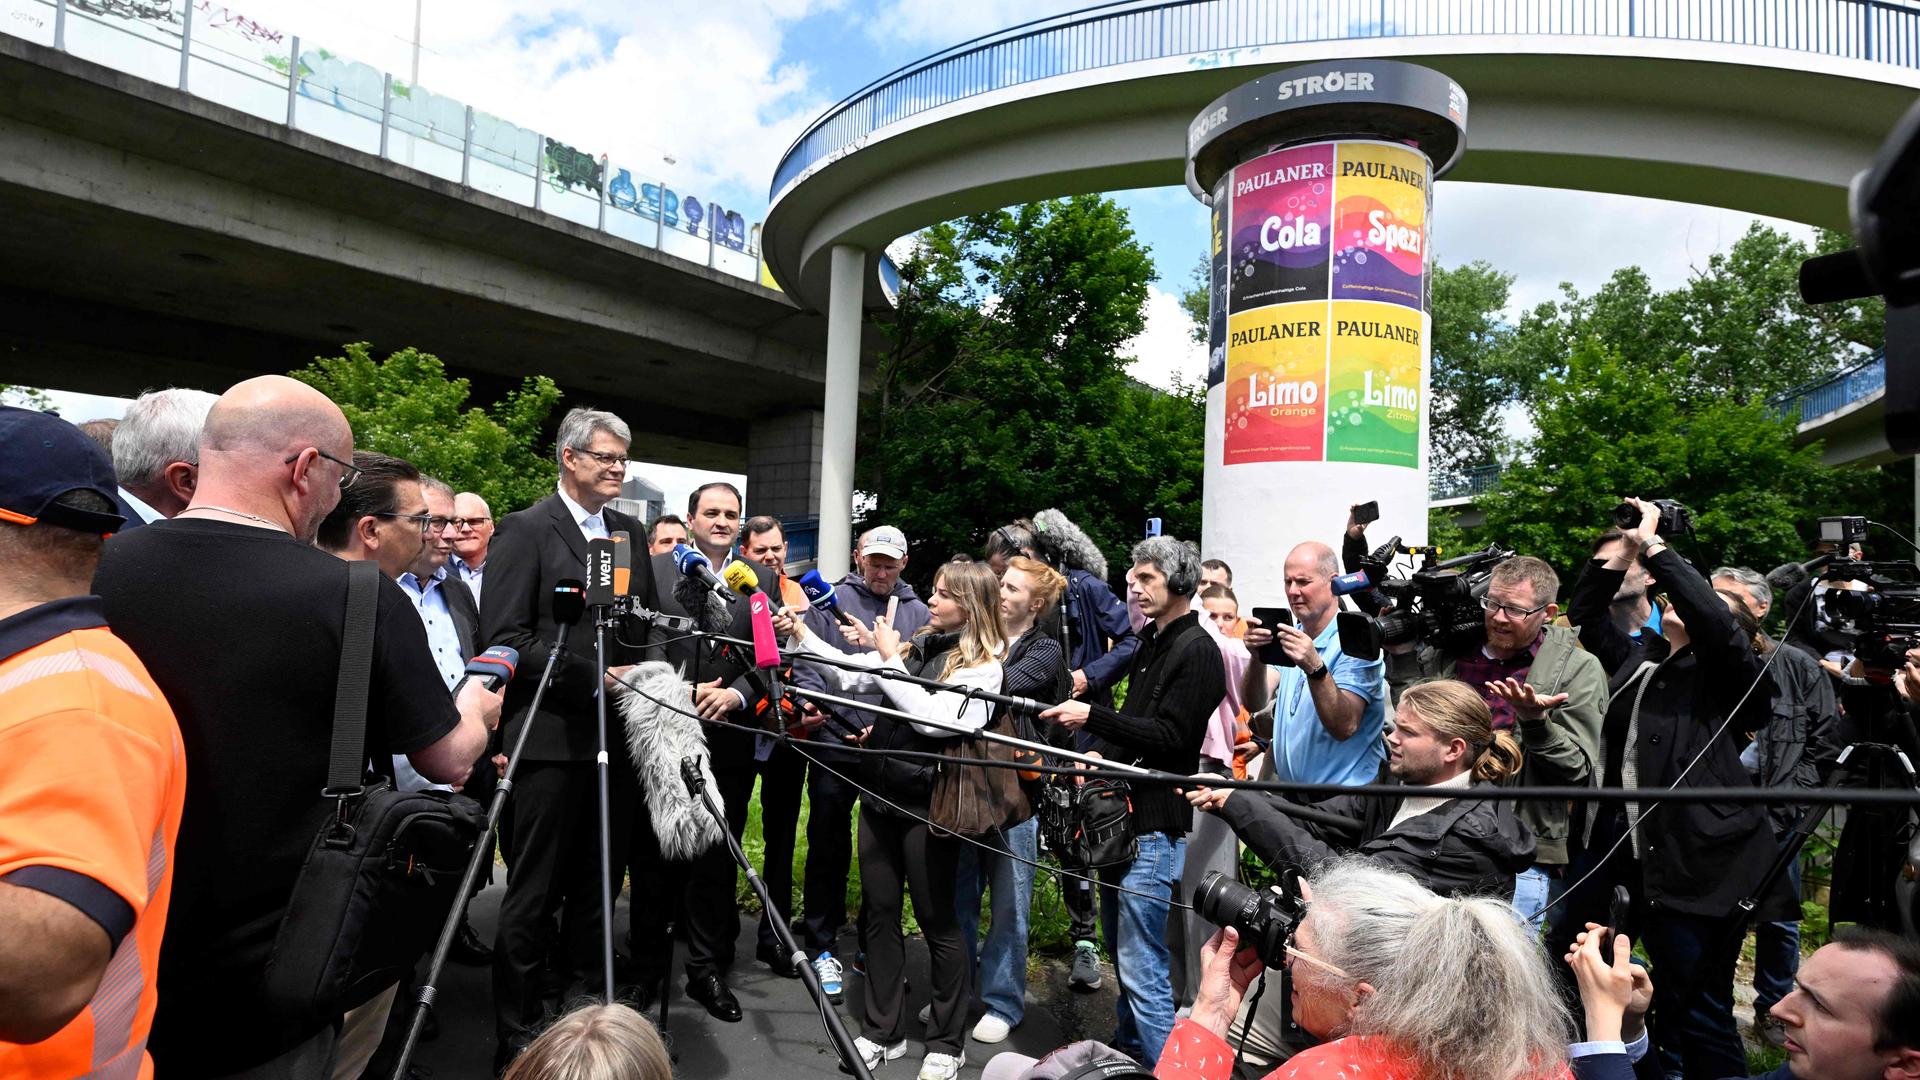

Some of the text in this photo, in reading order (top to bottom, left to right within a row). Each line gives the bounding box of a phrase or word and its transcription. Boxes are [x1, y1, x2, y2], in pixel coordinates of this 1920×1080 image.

[1278, 71, 1375, 100] STRÖER
[1236, 162, 1326, 198] PAULANER
[1342, 161, 1424, 191] PAULANER
[1260, 214, 1322, 252] Cola
[1367, 210, 1421, 255] Spezi
[1231, 321, 1321, 348] PAULANER
[1337, 320, 1419, 347] PAULANER
[1249, 373, 1318, 408] Limo
[1364, 368, 1418, 412] Limo
[1269, 407, 1317, 418] Orange
[1386, 408, 1417, 423] Zitrone
